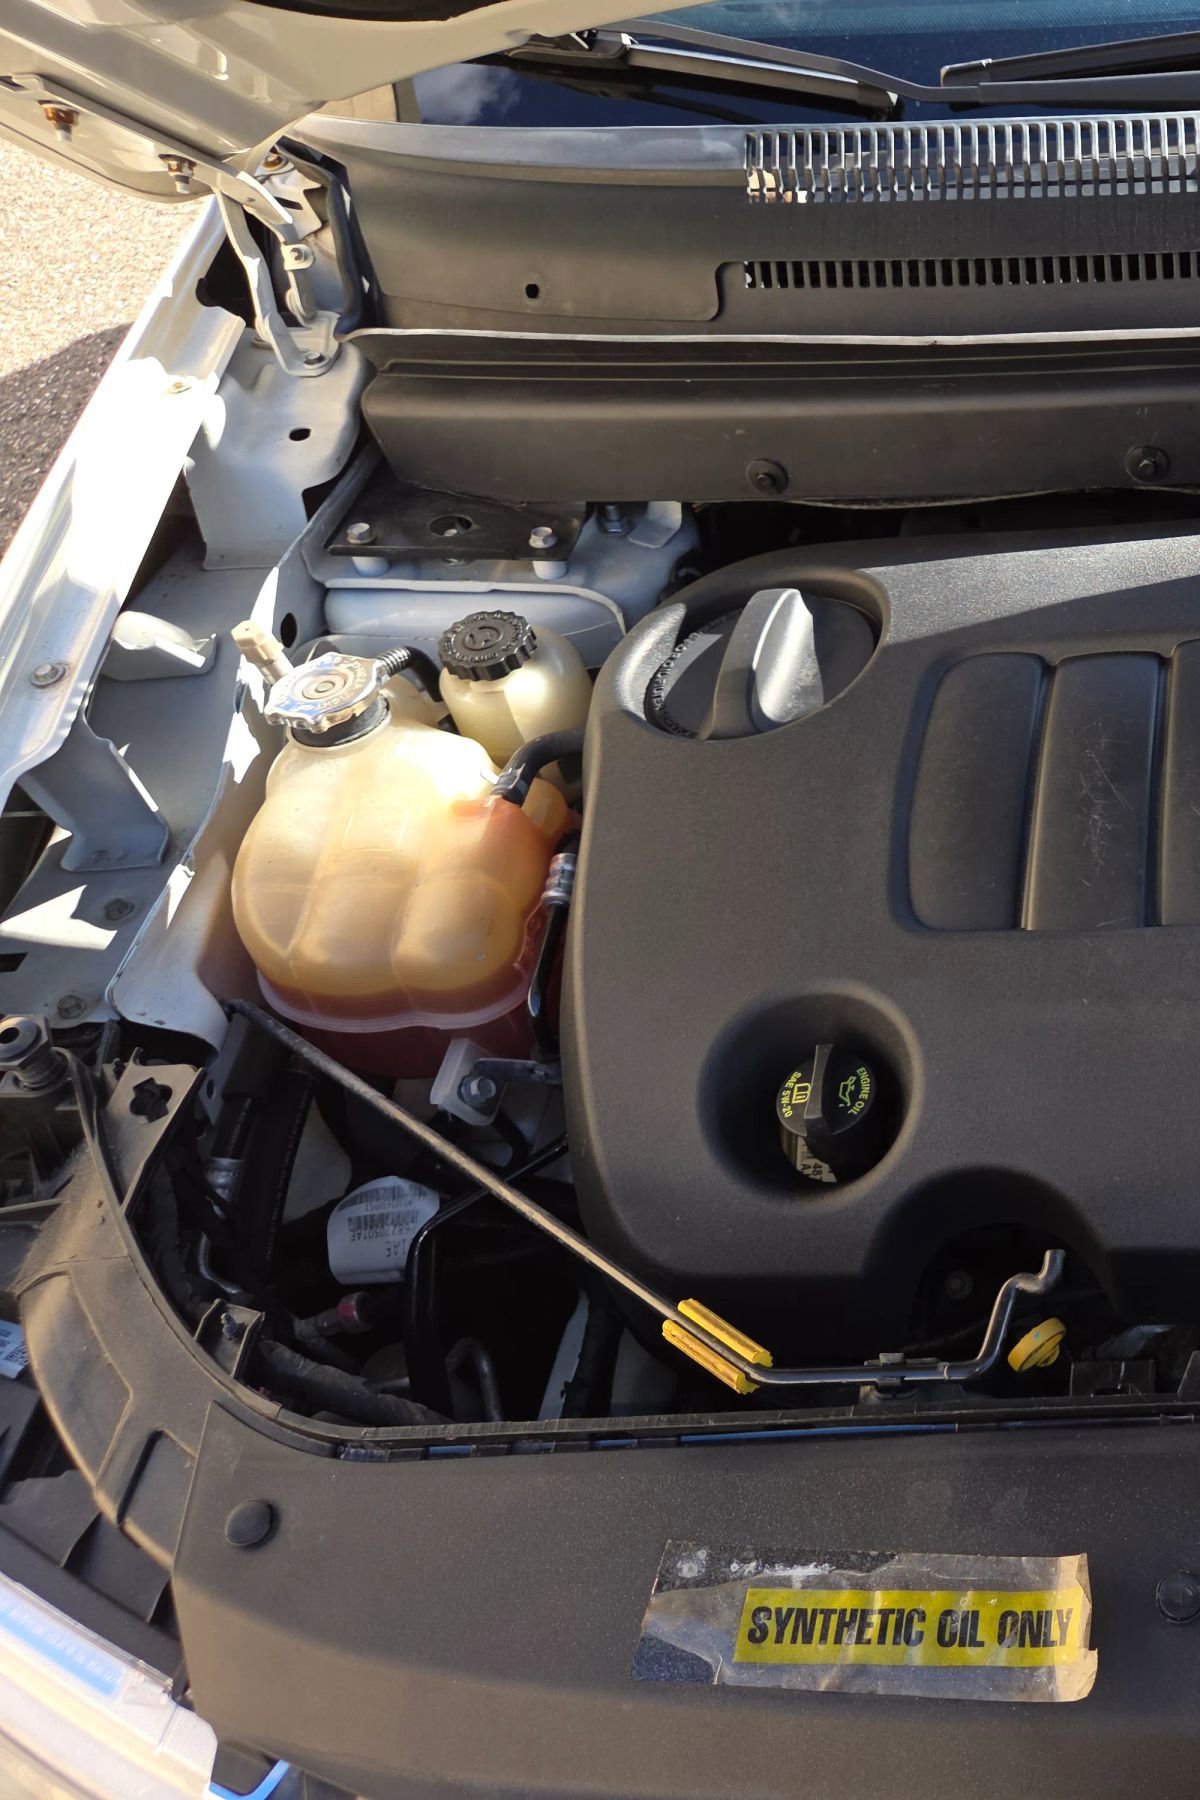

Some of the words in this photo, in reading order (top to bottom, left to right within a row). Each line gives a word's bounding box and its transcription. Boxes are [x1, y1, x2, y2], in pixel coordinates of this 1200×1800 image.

[785, 1071, 802, 1089] SAE
[857, 1067, 870, 1100] ENGINE
[781, 1090, 793, 1118] 5W-20
[847, 1101, 865, 1115] OIL
[747, 1606, 926, 1646] SYNTHETIC
[936, 1608, 985, 1648] OIL
[996, 1607, 1074, 1648] ONLY
